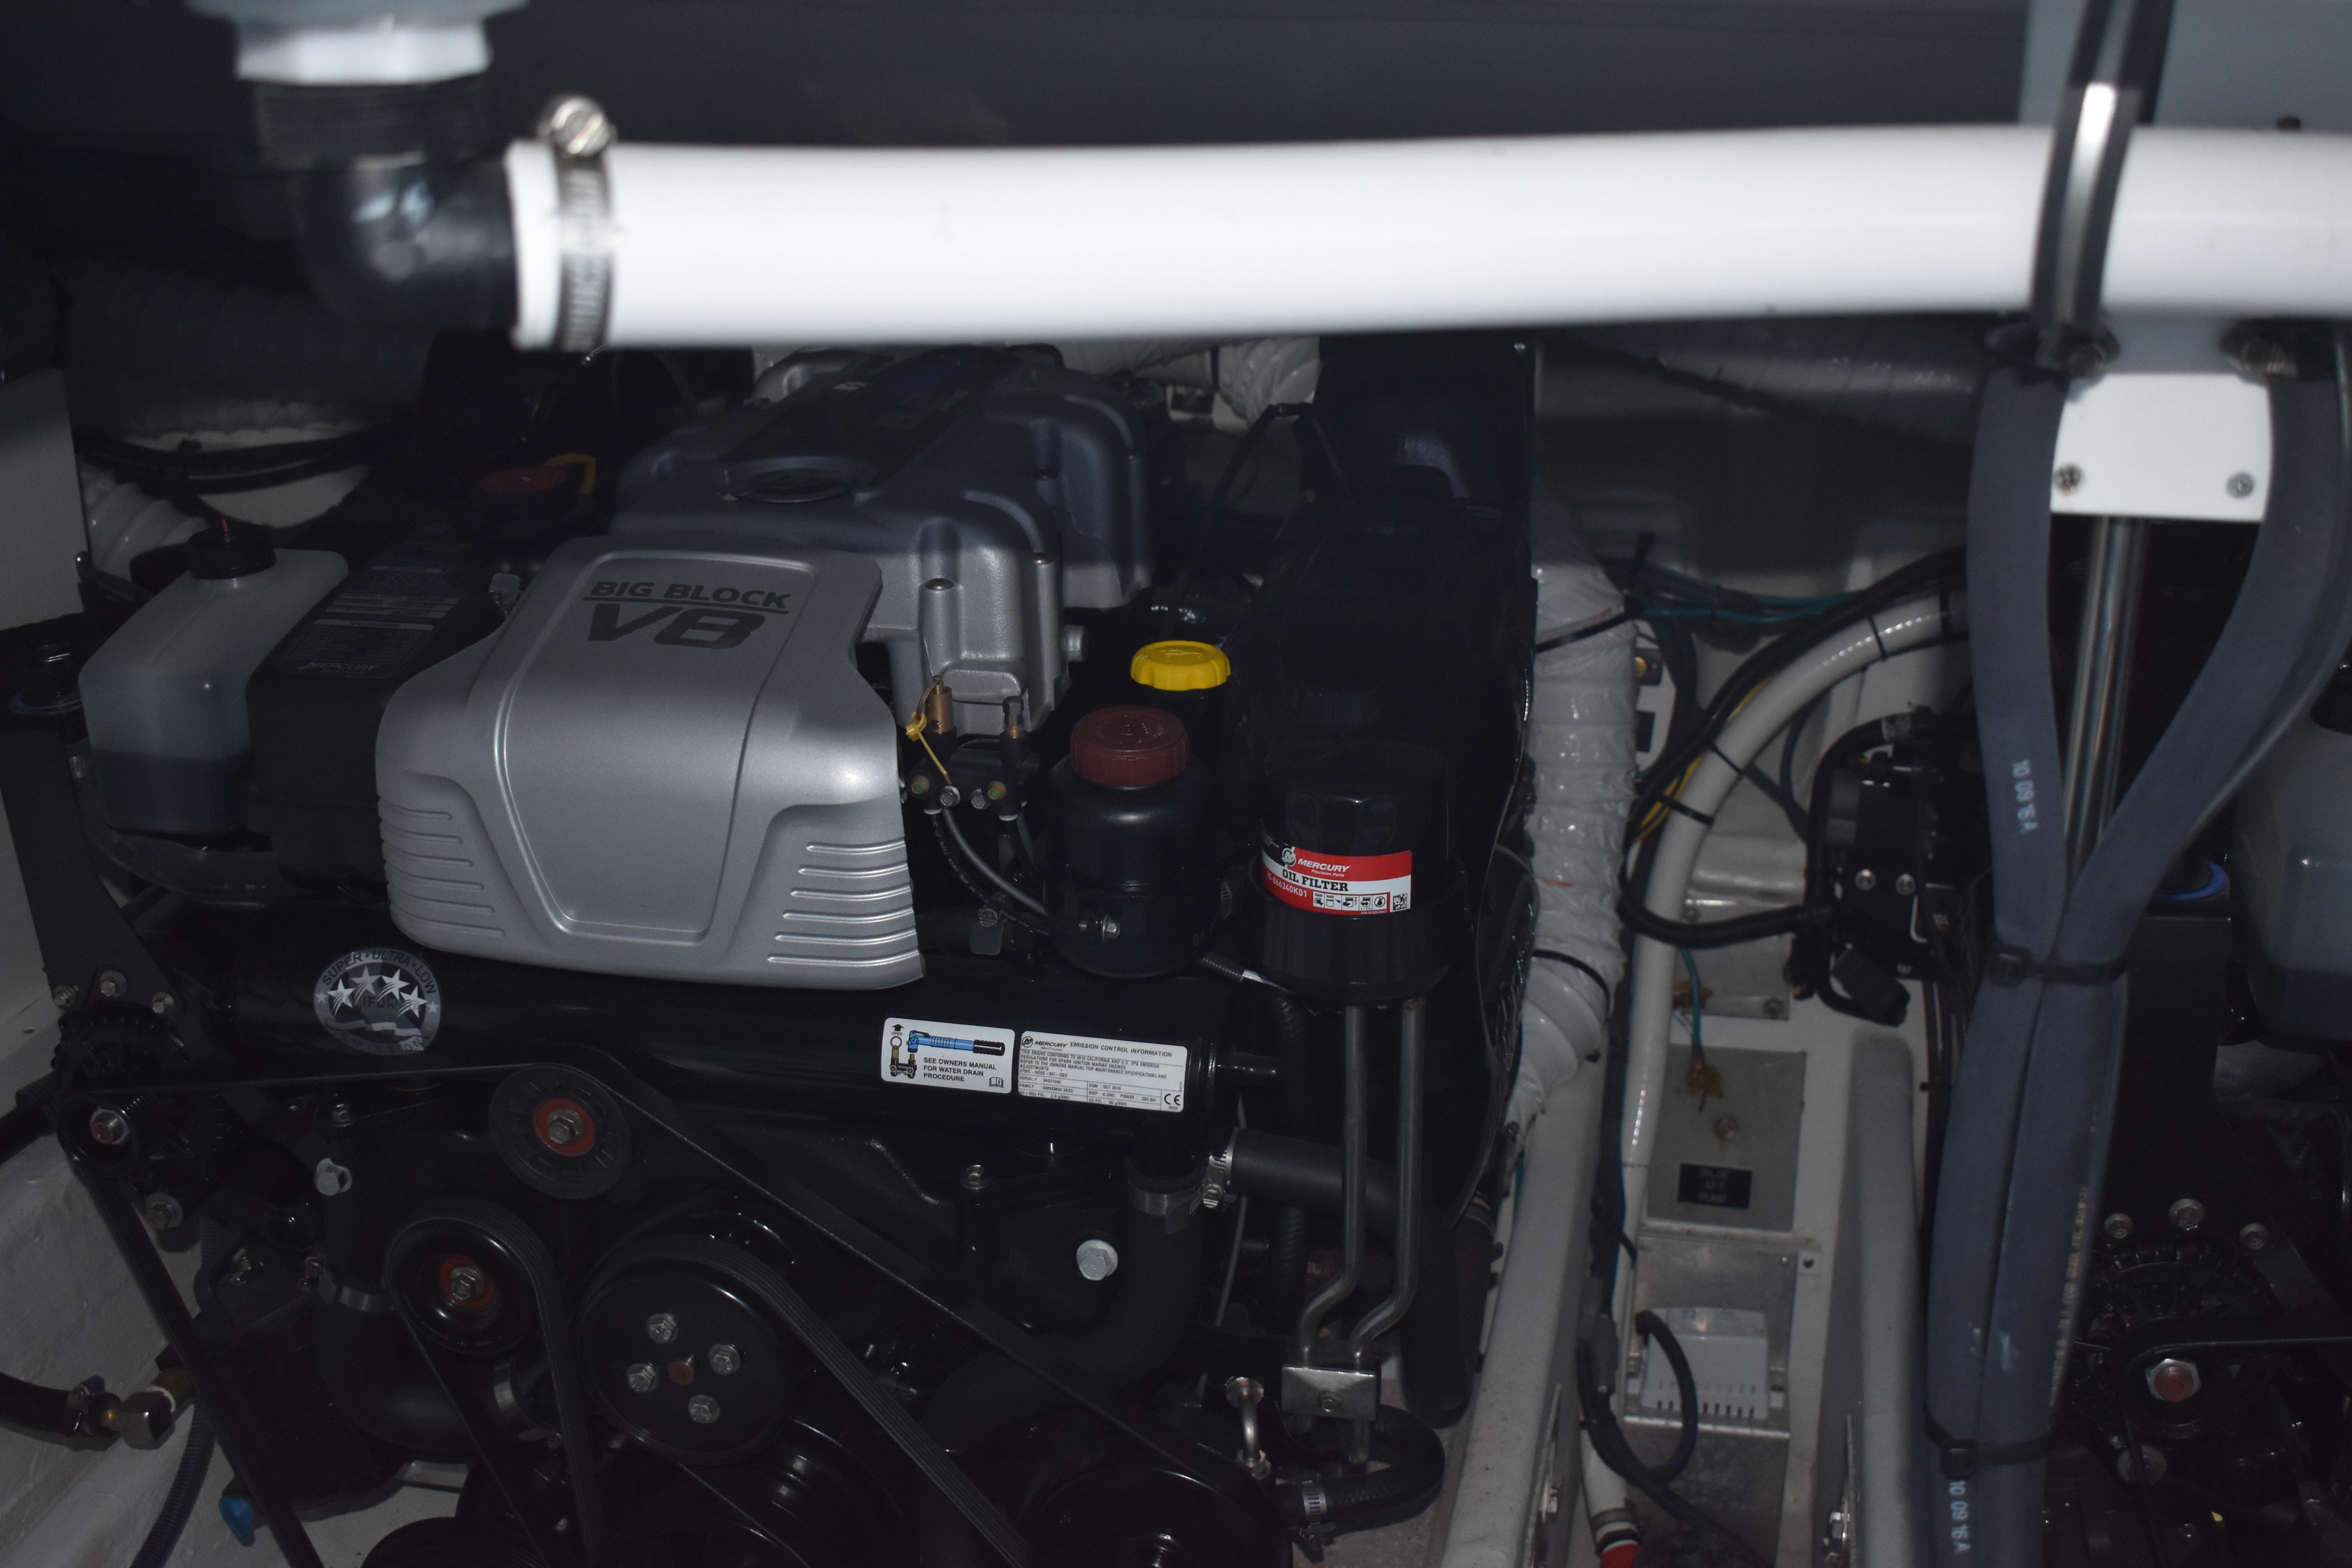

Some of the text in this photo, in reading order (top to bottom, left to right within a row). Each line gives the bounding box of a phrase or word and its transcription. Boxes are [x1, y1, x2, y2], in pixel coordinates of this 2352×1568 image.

[589, 581, 791, 609] BIG BLOCK
[588, 603, 766, 649] V8
[1298, 858, 1350, 873] MERCURY
[1282, 869, 1348, 891] OIL FILTER
[322, 950, 436, 994] SUPER ULTRA LOW
[1131, 1048, 1172, 1057] INFORMATION
[969, 1062, 997, 1070] MANUAL
[924, 1073, 964, 1082] PROCEDURE
[1164, 1093, 1181, 1106] CE
[1949, 1479, 1966, 1495] 10
[1950, 1500, 1968, 1520] 09
